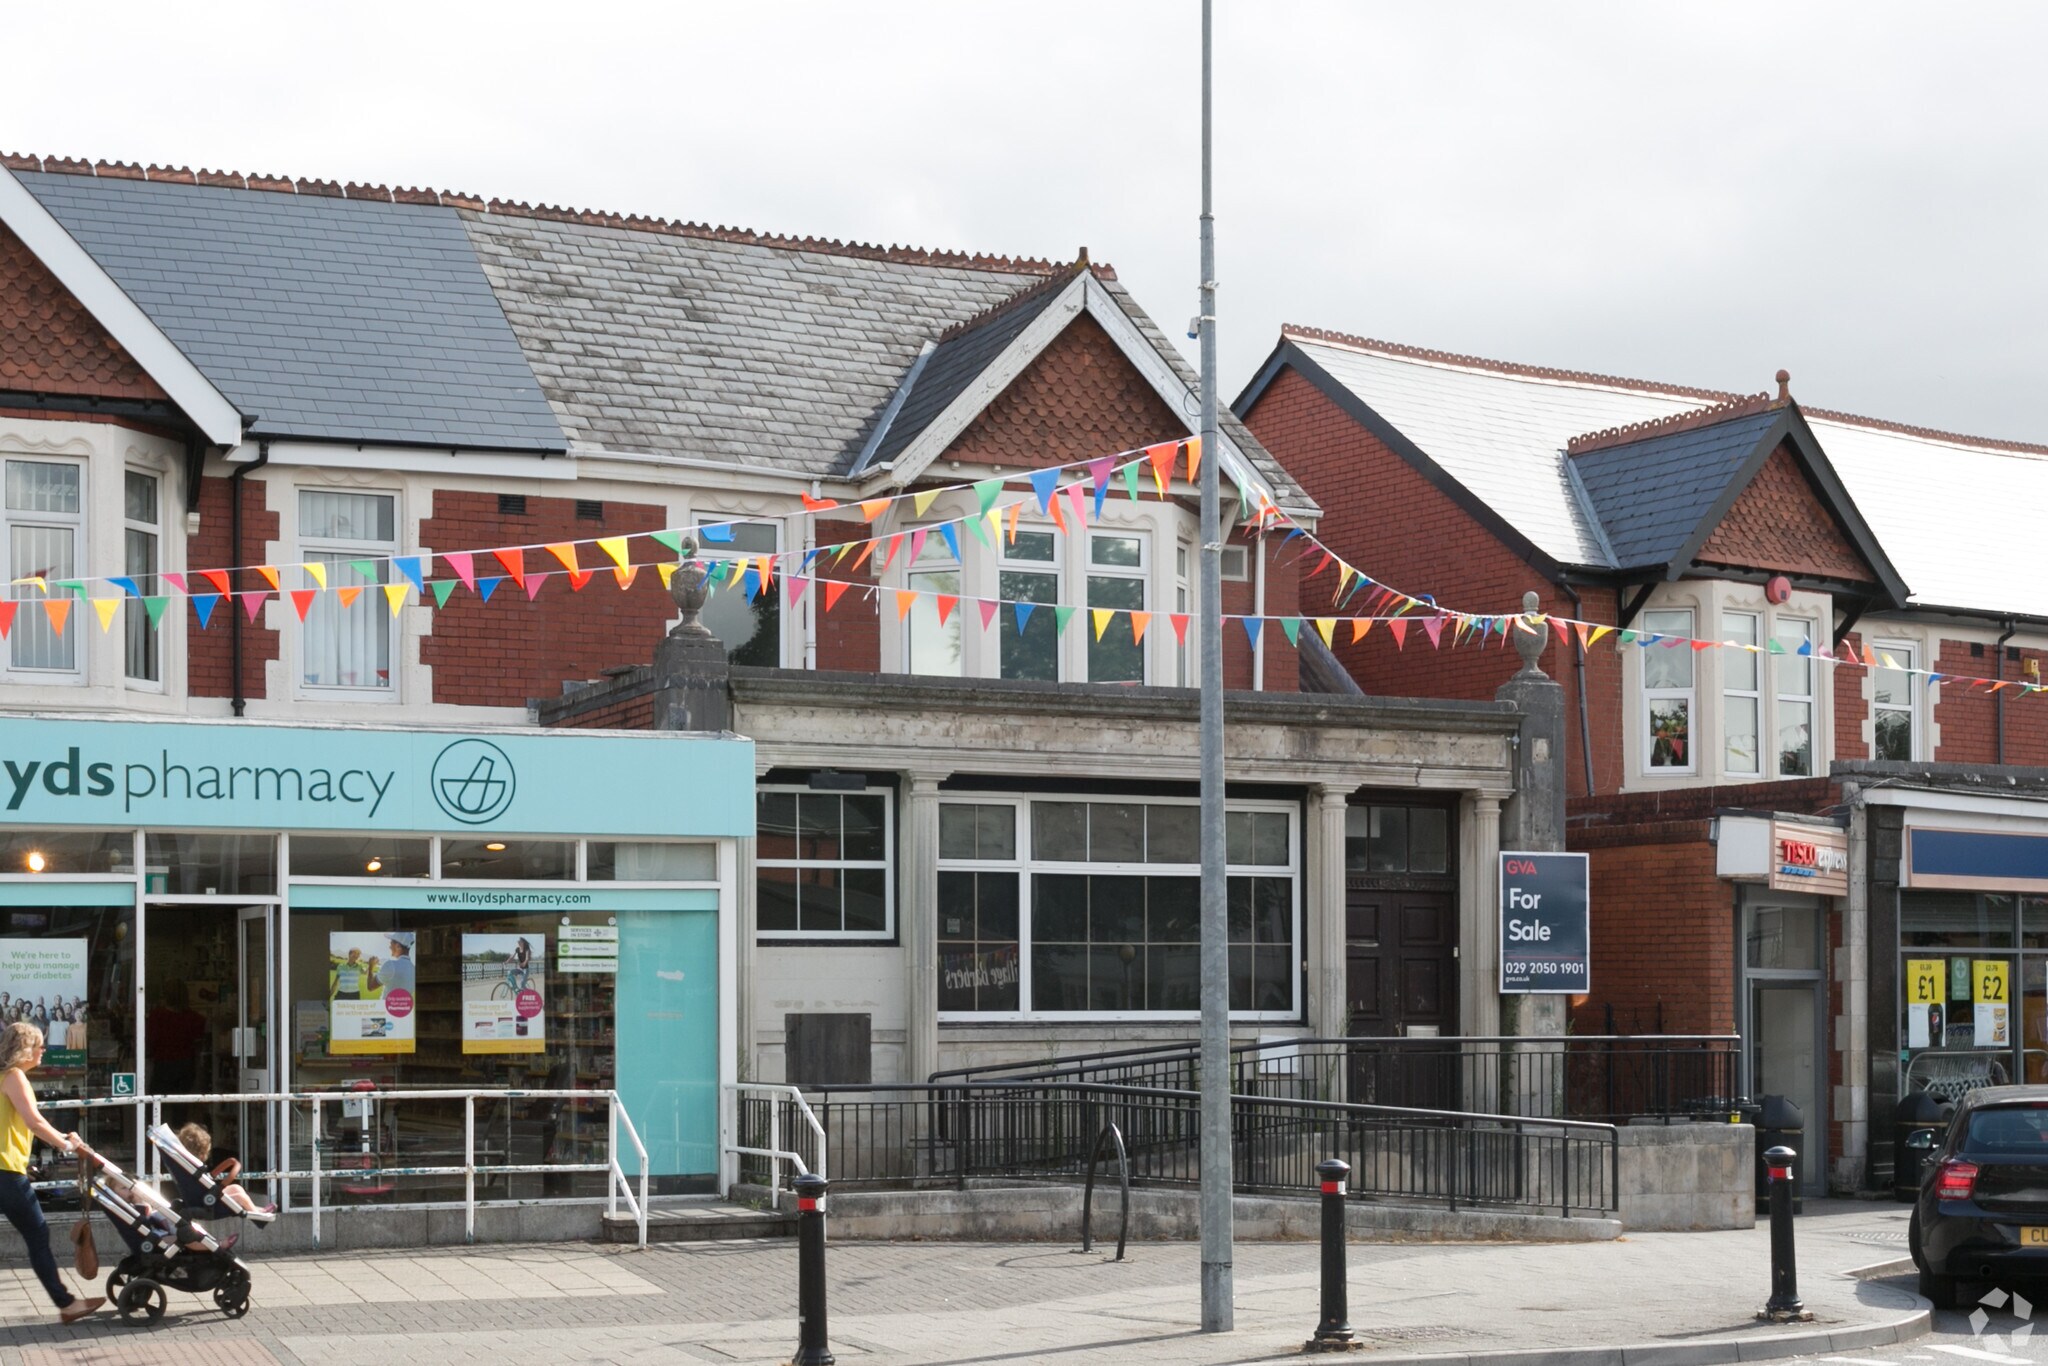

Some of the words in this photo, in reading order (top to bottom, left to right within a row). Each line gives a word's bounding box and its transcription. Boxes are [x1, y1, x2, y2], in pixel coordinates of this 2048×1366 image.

[1781, 839, 1816, 866] TESCO
[1816, 847, 1847, 875] express
[1506, 860, 1537, 875] GVA
[427, 892, 591, 906] www.lloydspharmacy.com
[1509, 887, 1541, 909] For
[1508, 919, 1551, 941] Sale
[2, 962, 22, 971] help
[24, 963, 41, 971] you
[43, 963, 80, 971] manage
[1505, 962, 1527, 974] 029
[1529, 962, 1557, 974] 2050
[1560, 963, 1584, 974] 1901
[10, 973, 31, 981] your
[33, 972, 72, 980] diabetes
[1918, 975, 1935, 1000] £1
[1983, 976, 2002, 1000] £2
